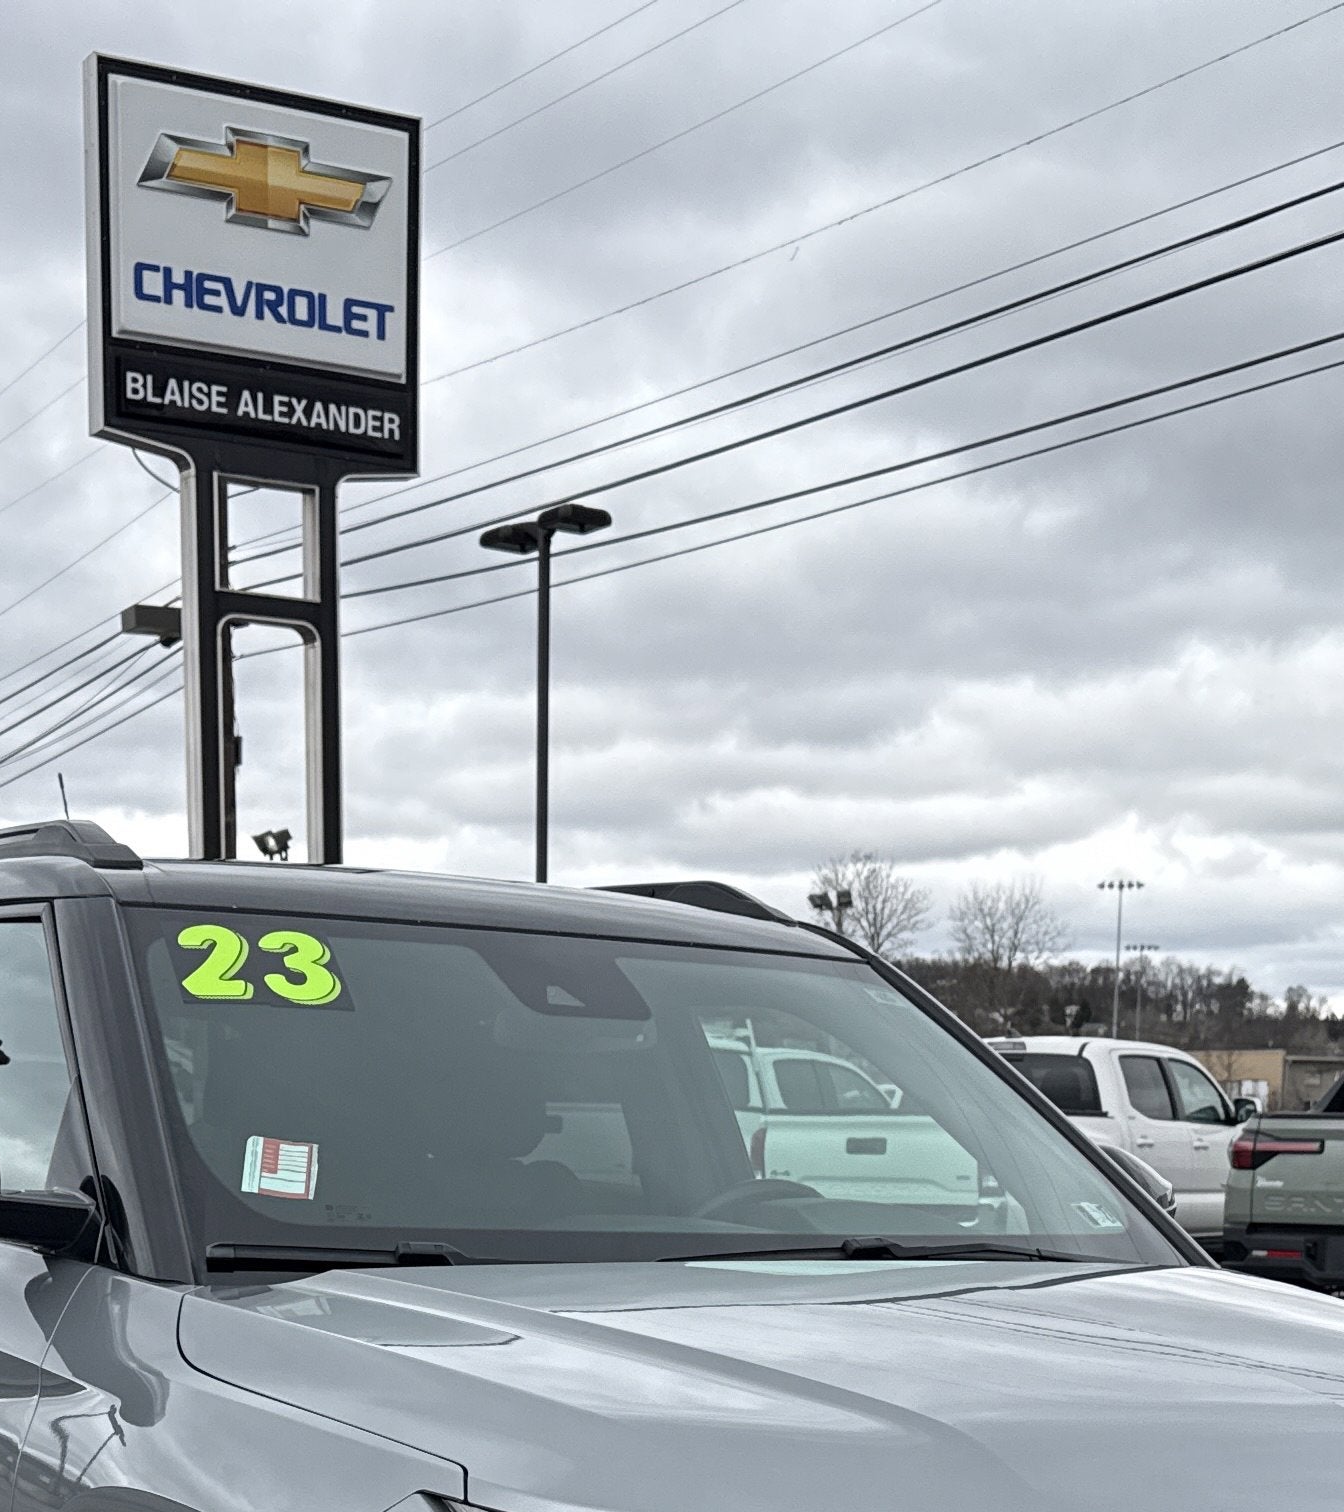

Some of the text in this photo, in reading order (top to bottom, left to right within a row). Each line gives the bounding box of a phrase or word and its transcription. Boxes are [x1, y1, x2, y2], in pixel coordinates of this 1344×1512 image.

[134, 262, 395, 341] CHEVROLET
[125, 371, 401, 441] BLAISE ALEXANDER
[177, 924, 342, 1005] 23
